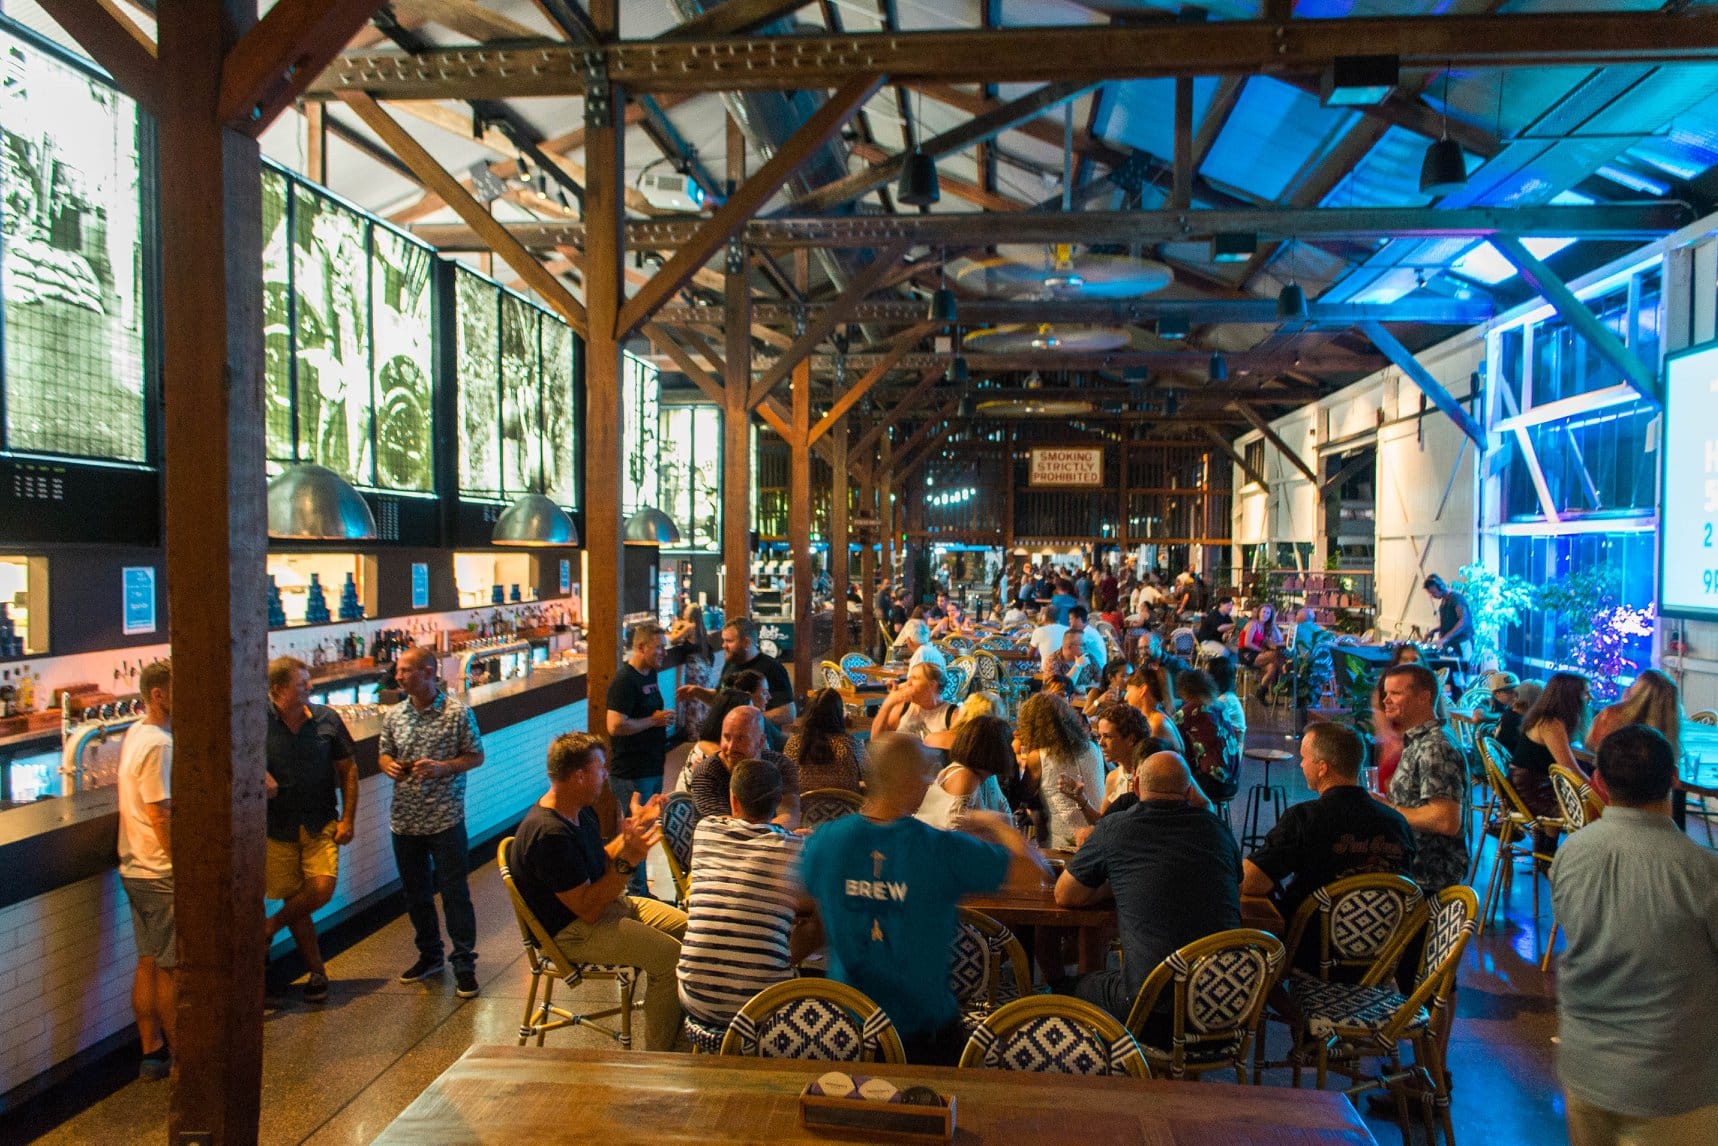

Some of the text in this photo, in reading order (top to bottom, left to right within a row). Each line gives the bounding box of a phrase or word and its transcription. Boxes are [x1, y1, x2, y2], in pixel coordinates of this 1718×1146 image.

[1041, 452, 1092, 461] SMOKING
[1037, 462, 1095, 472] STRICTLY
[1033, 472, 1098, 481] PROHIBITED
[845, 879, 908, 902] BREW
